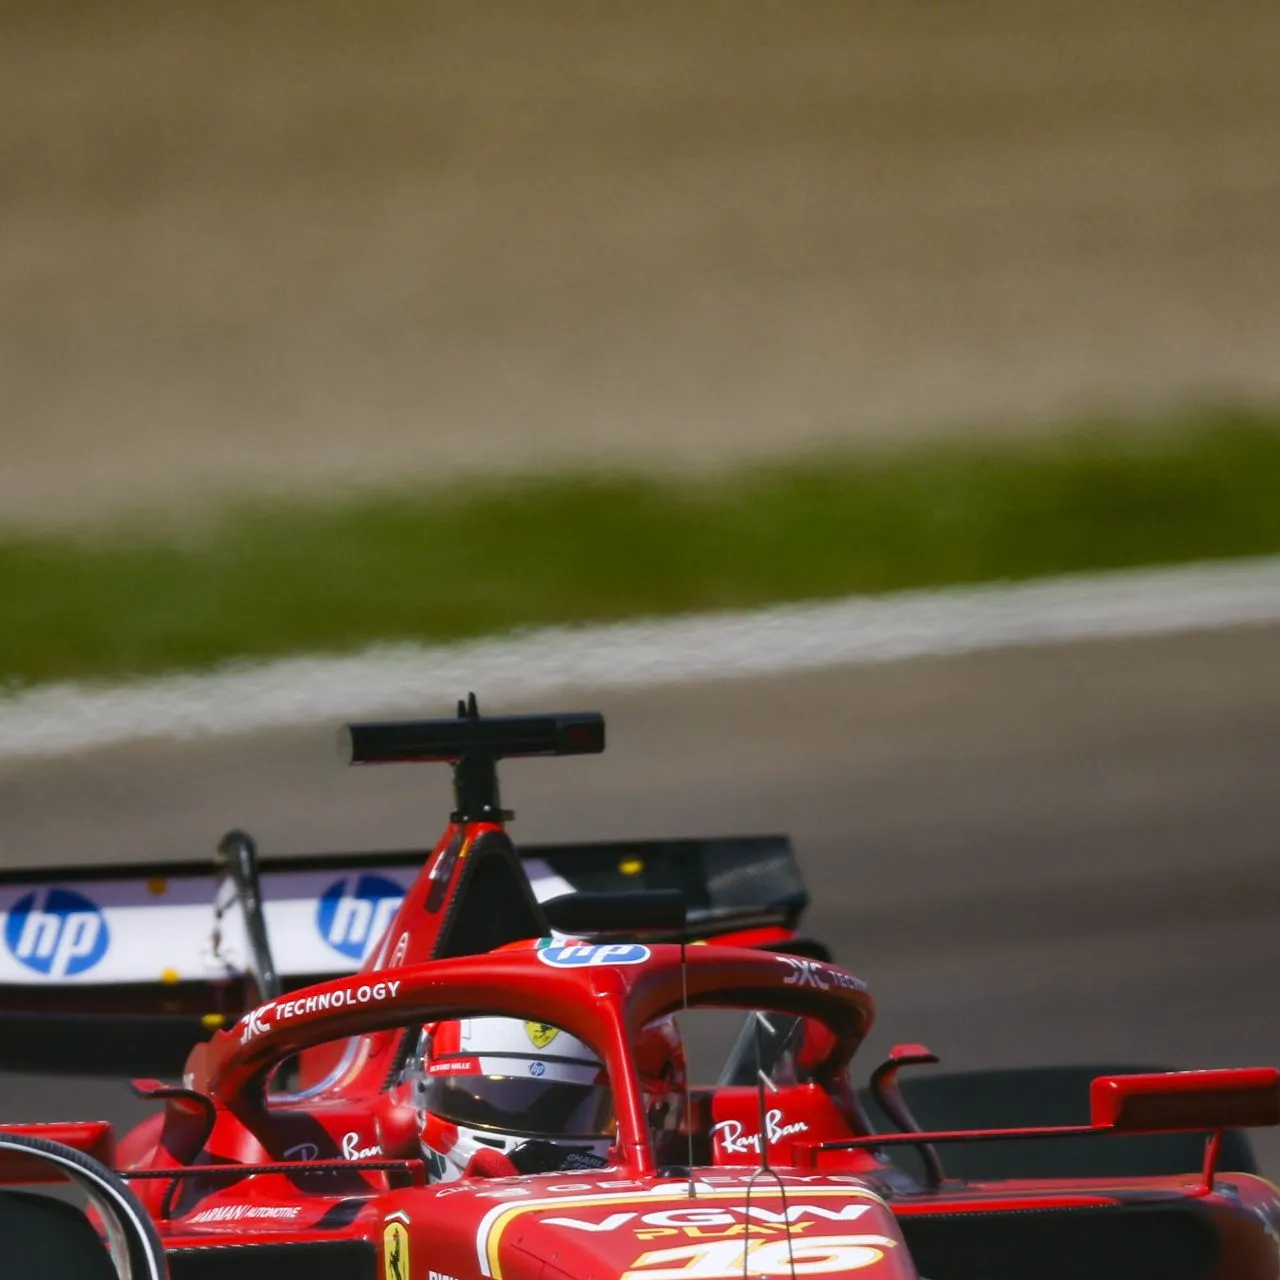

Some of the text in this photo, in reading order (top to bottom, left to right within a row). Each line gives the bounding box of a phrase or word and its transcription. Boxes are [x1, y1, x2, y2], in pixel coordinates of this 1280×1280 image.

[16, 888, 102, 978] hp
[276, 981, 401, 1020] TECHNOLOGY
[539, 1204, 872, 1232] VGW
[633, 1221, 816, 1241] PLAY
